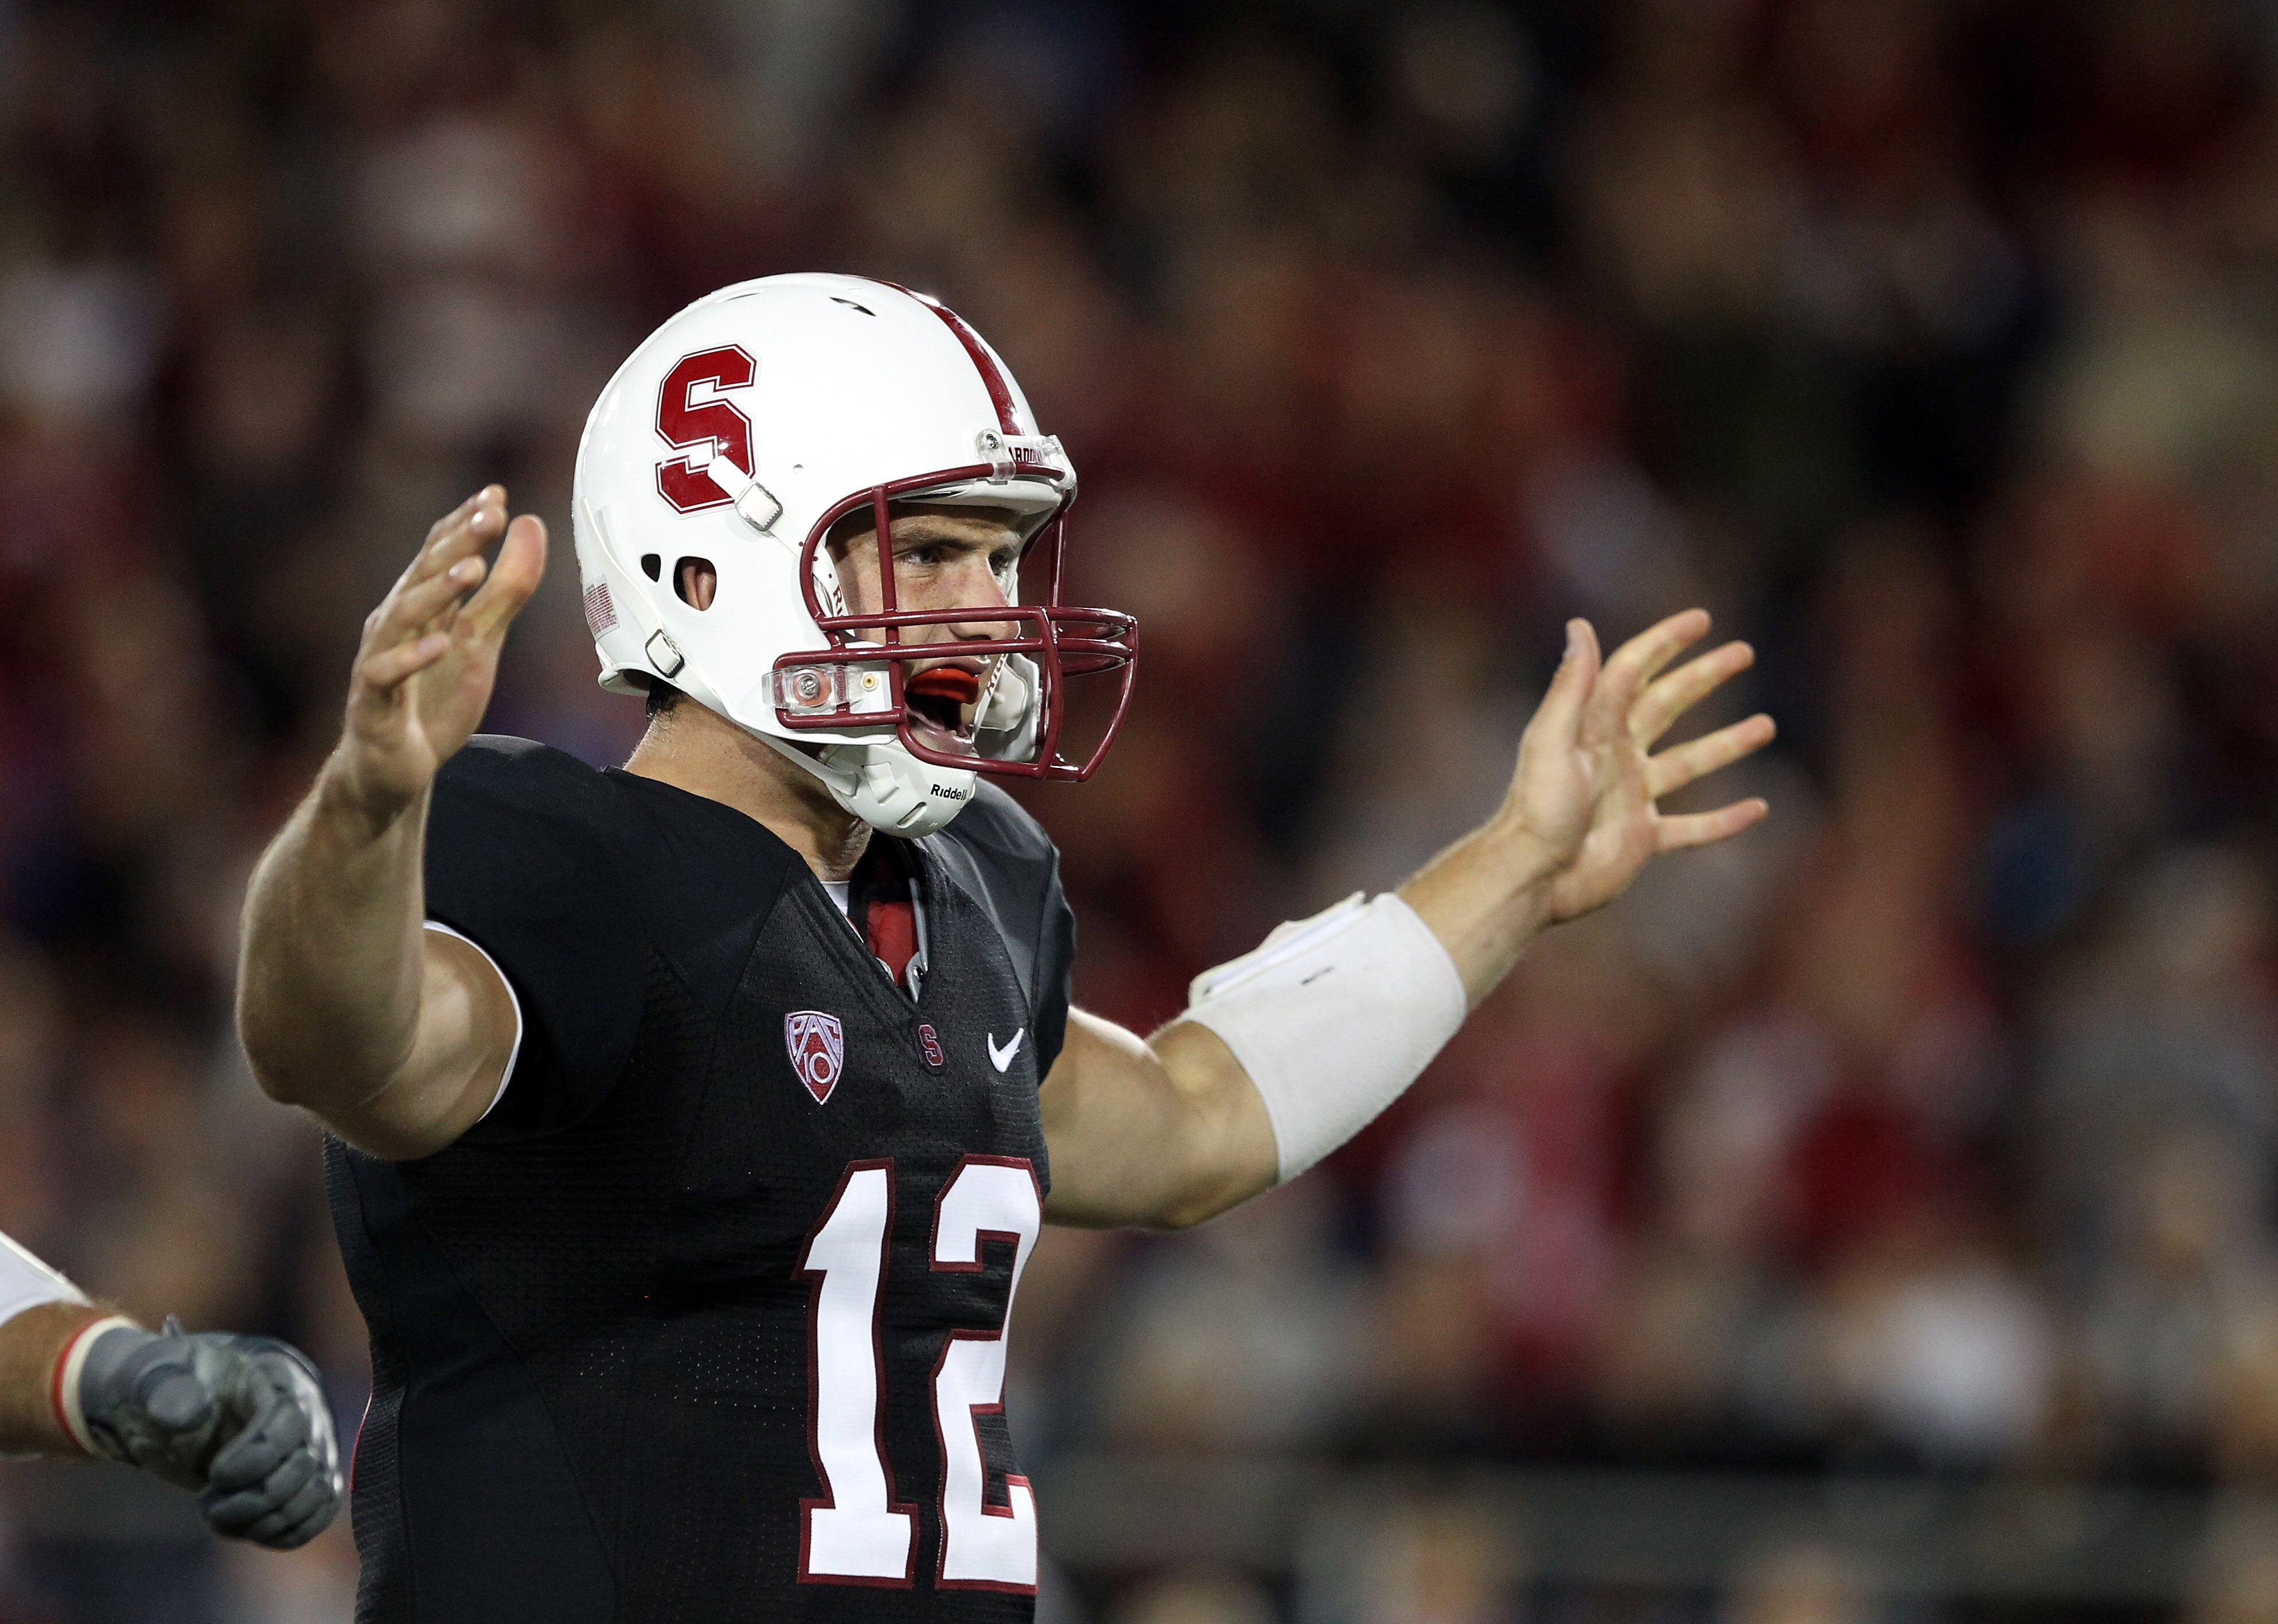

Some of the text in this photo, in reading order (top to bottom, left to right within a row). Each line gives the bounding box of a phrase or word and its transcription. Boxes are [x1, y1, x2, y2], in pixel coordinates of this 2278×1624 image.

[655, 343, 757, 514] S
[930, 783, 968, 801] Riddell
[789, 1015, 841, 1069] PAC
[918, 1024, 943, 1066] S
[803, 1052, 835, 1084] 10
[791, 1154, 1041, 1595] 12
